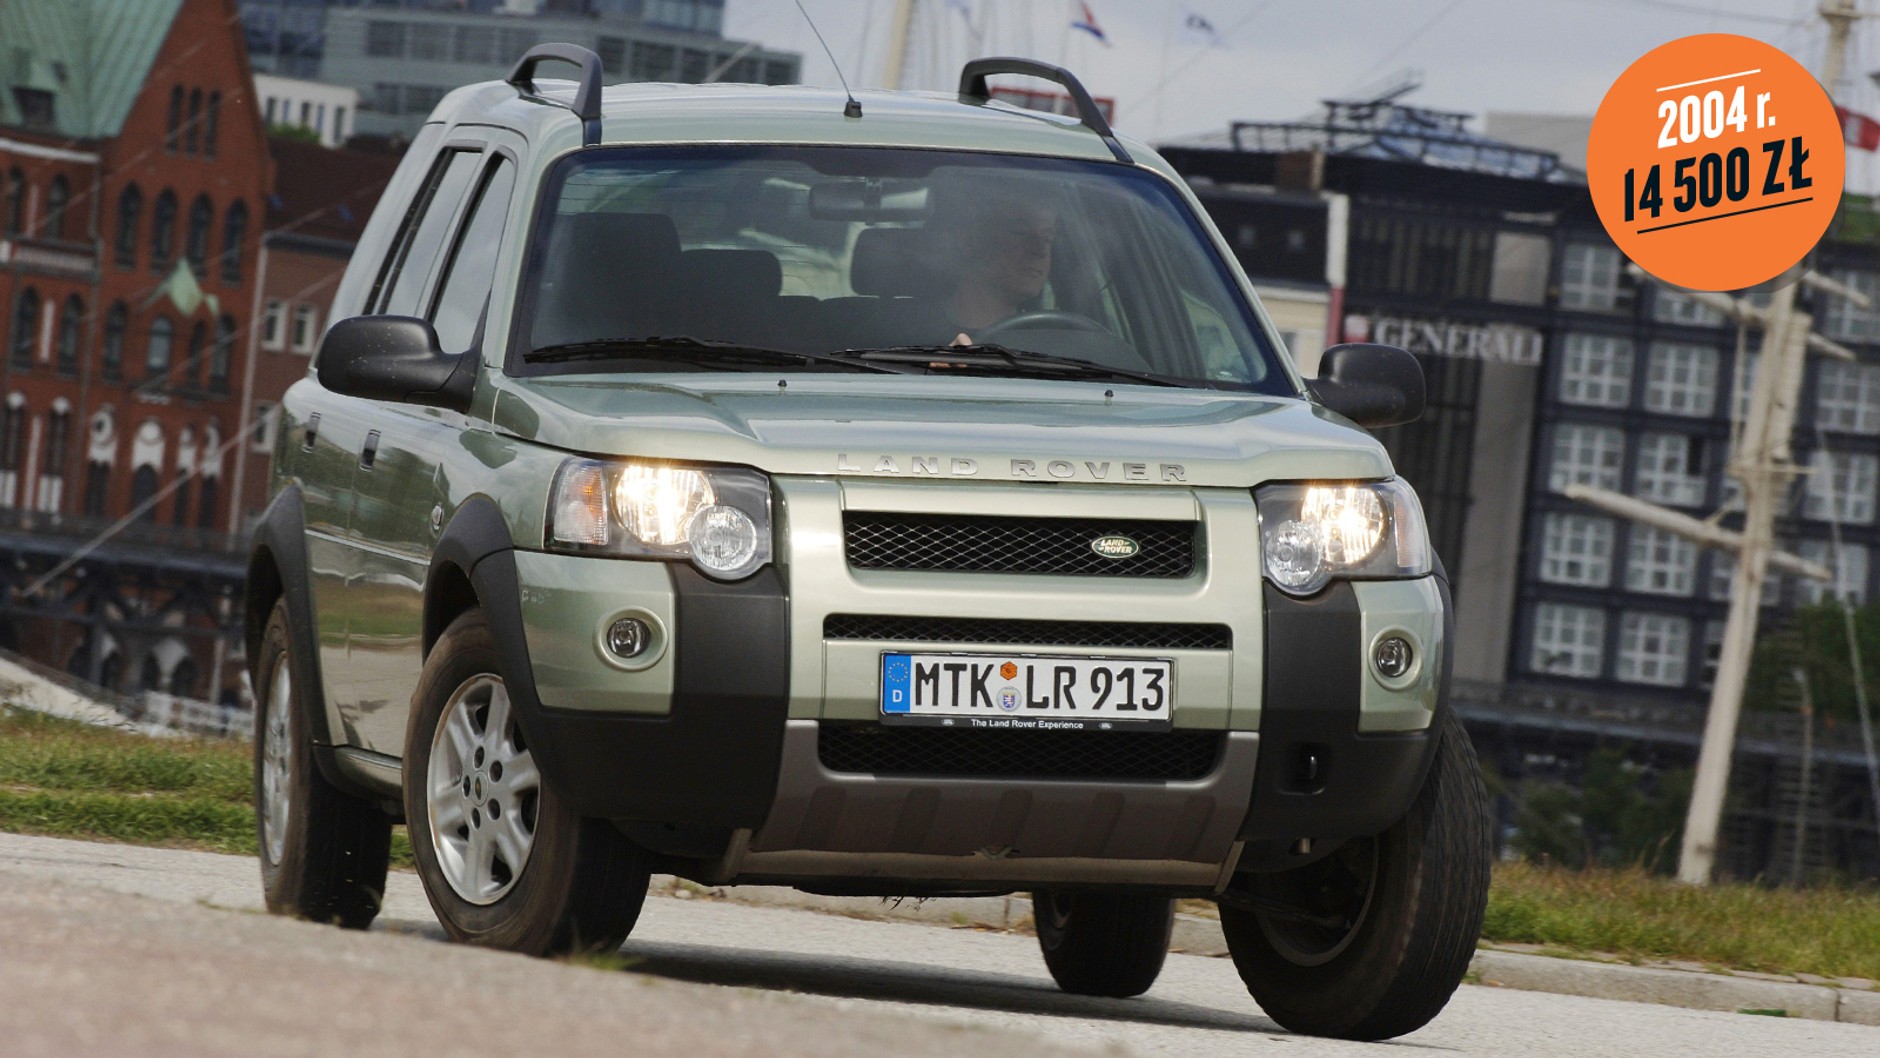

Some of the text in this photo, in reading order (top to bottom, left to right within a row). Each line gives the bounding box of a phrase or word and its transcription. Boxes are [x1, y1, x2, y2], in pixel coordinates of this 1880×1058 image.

[1374, 317, 1544, 366] GENERALI
[837, 453, 1187, 482] LAND ROVER
[1101, 539, 1125, 547] LAND
[1103, 545, 1133, 554] ROVER
[915, 662, 1165, 711] MTK LR 913
[892, 689, 903, 703] D
[971, 718, 1084, 730] The Land Rover Experience
